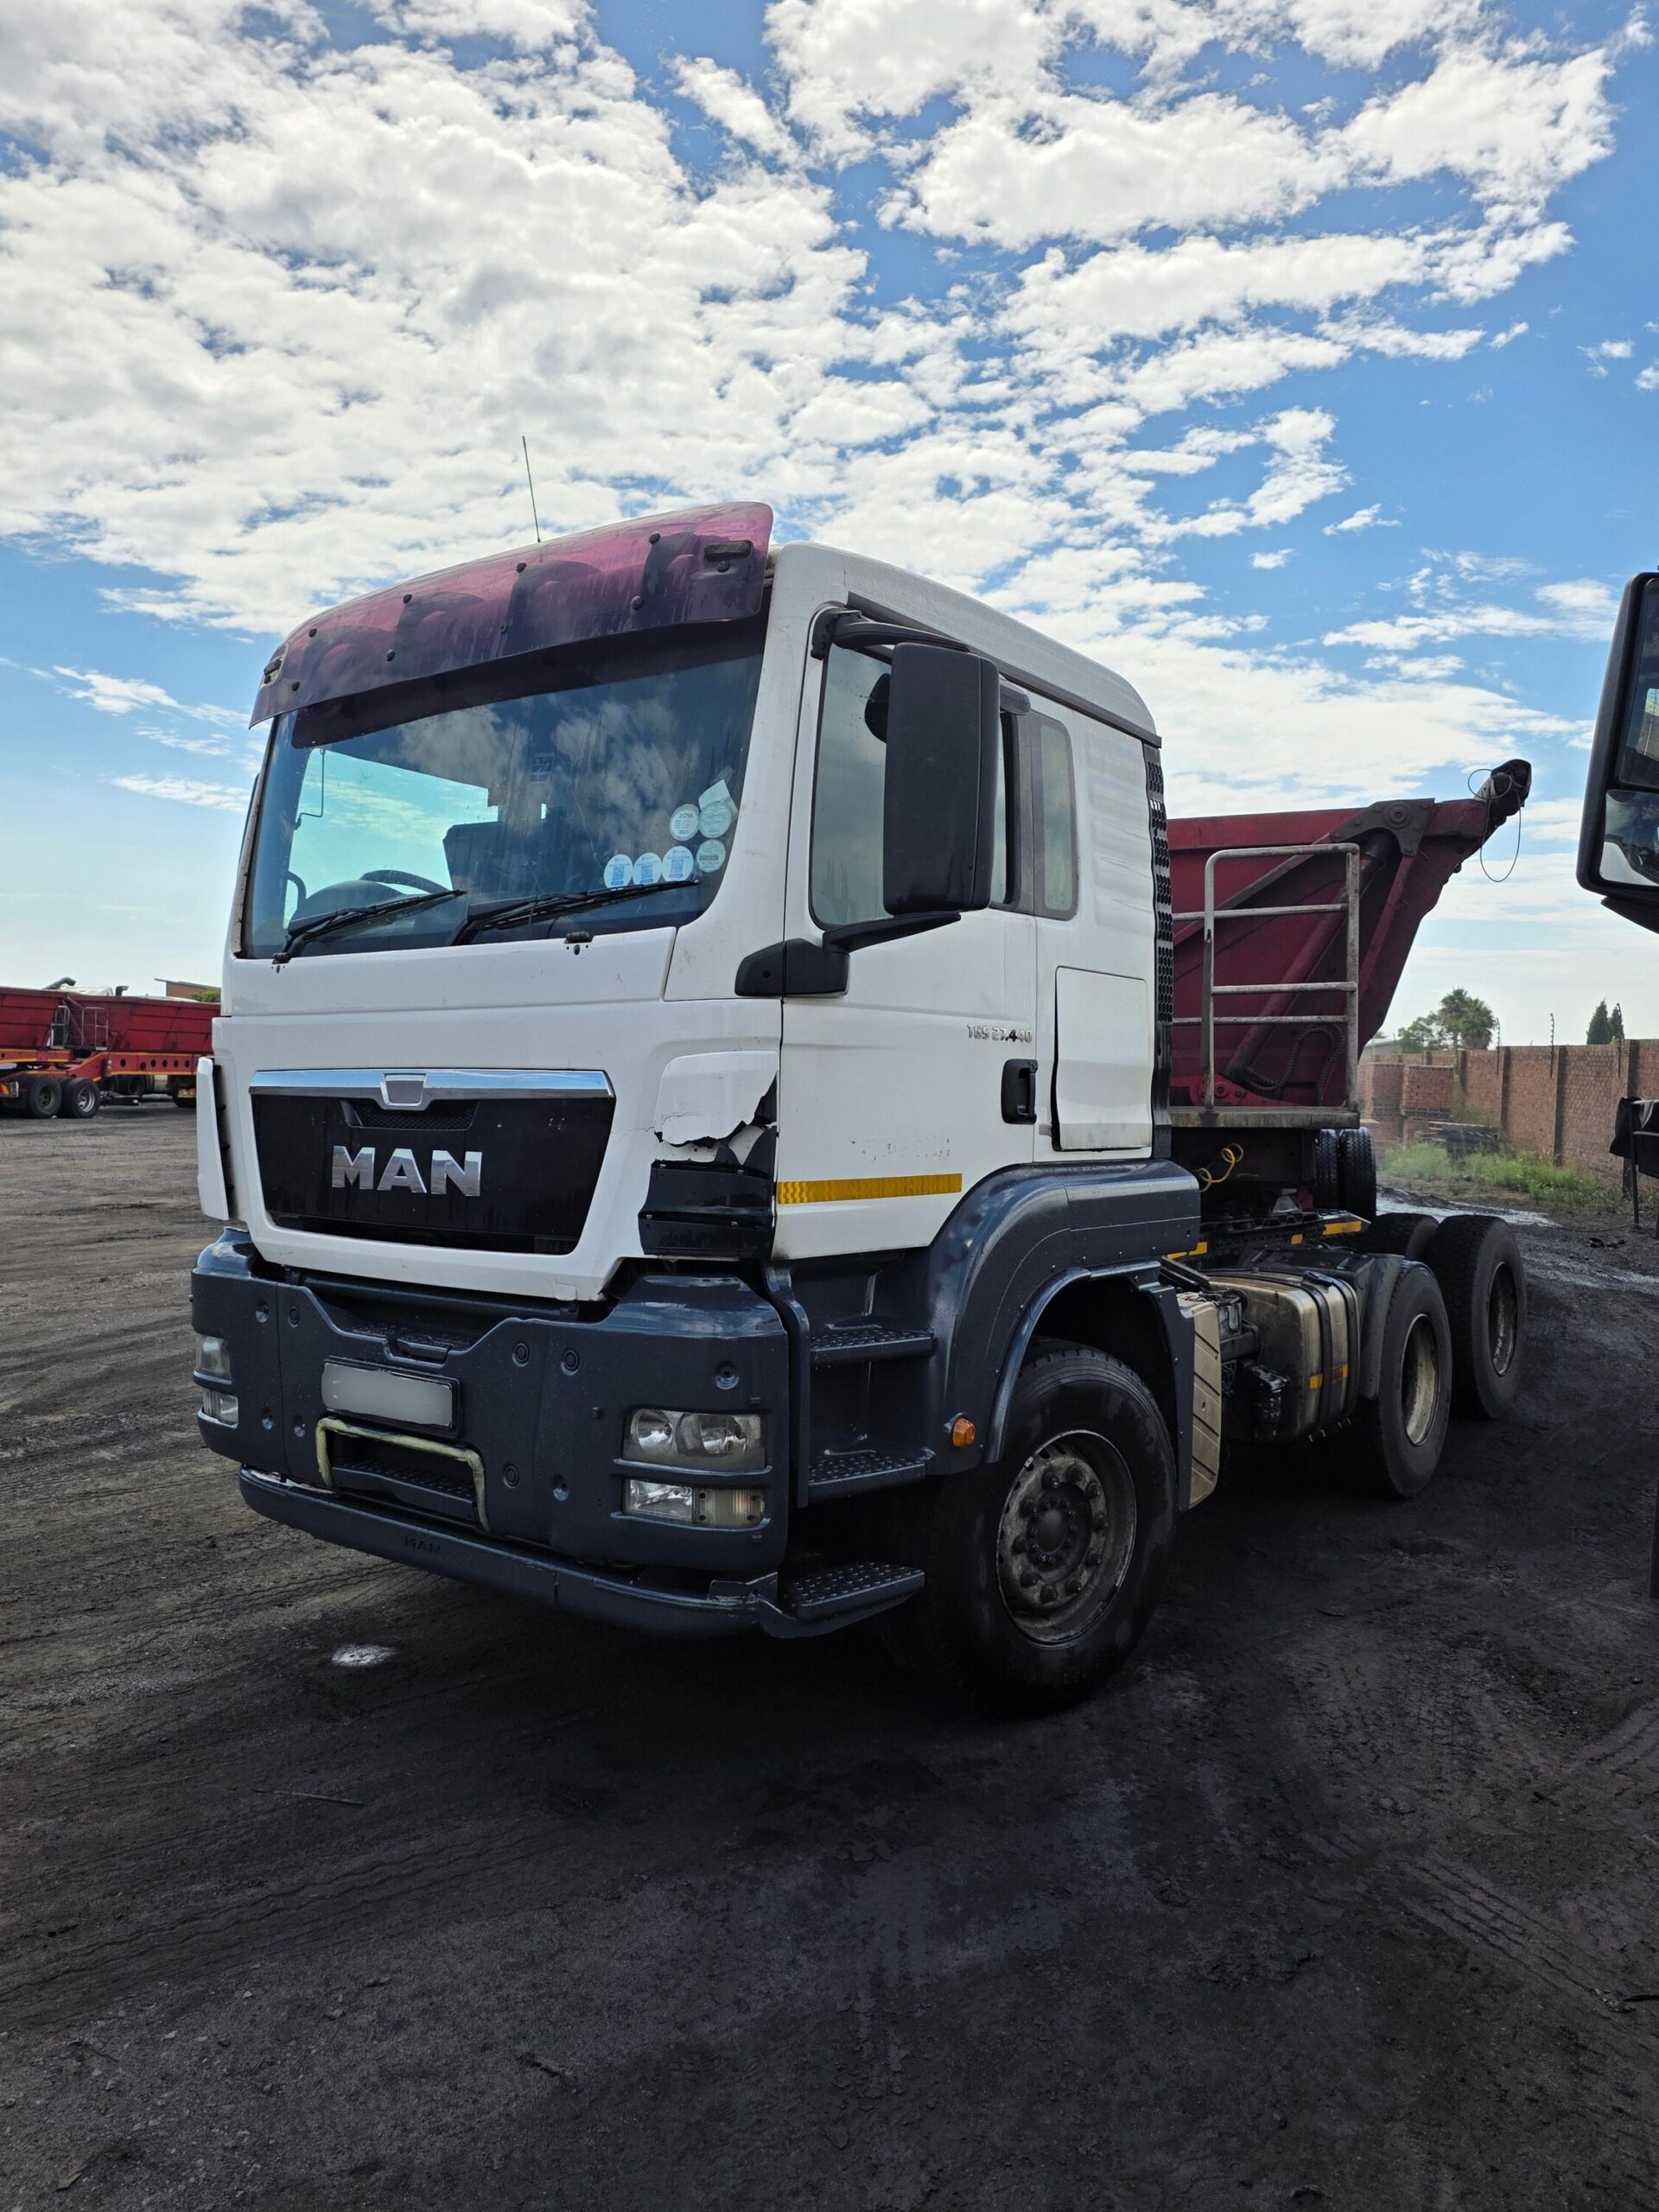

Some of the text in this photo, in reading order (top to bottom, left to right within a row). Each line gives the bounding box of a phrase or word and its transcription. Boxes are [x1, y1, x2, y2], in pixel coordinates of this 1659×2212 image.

[967, 1024, 1033, 1043] TGS 27.440
[332, 1145, 482, 1197] MAN
[404, 1536, 441, 1554] MAN
